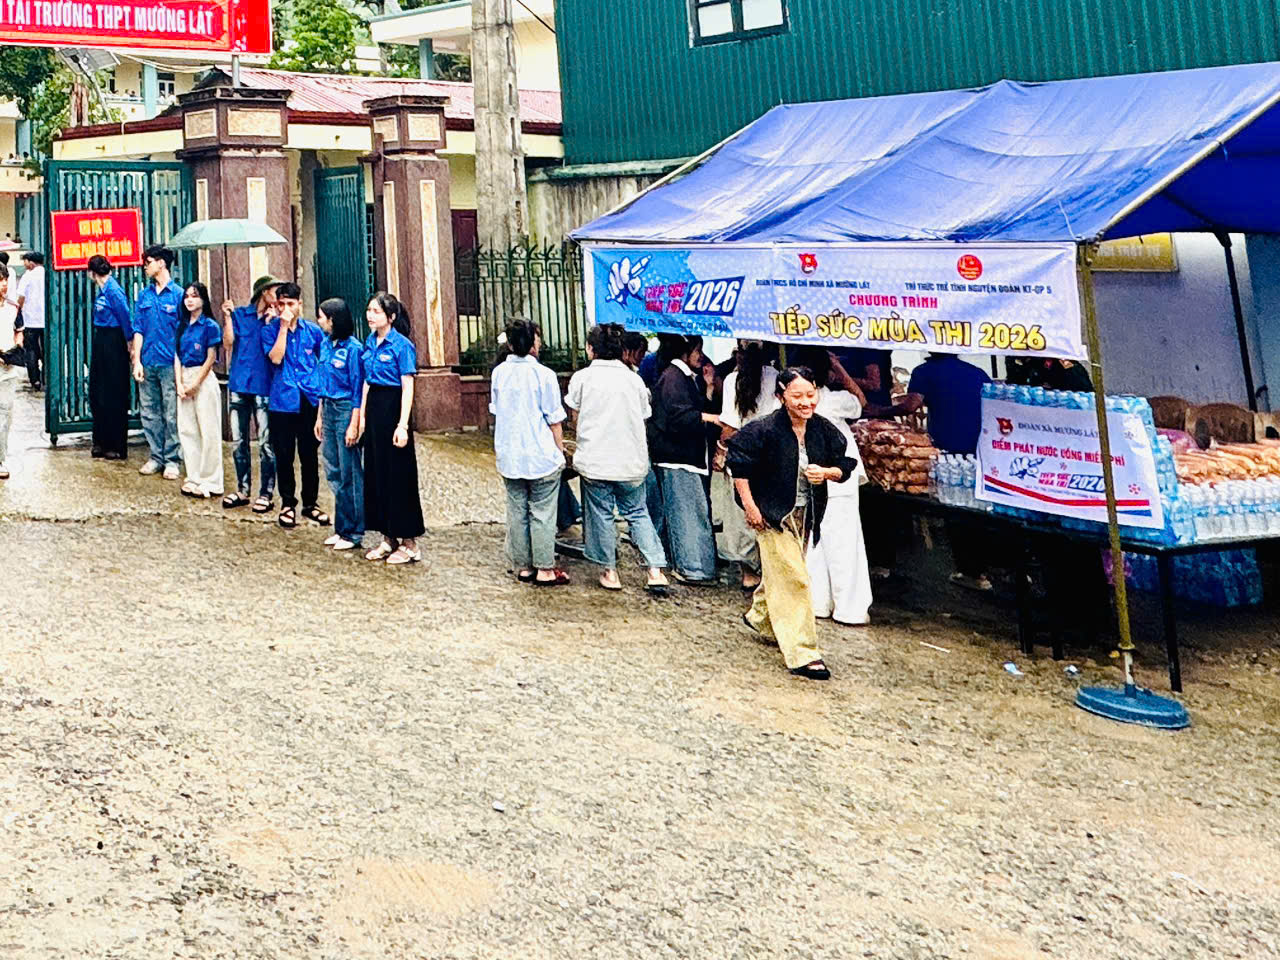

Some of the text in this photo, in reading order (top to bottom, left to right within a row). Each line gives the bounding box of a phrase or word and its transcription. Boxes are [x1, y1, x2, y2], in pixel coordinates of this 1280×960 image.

[96, 4, 130, 31] THPT
[134, 2, 186, 34] MƯỜNG
[189, 6, 214, 35] LÁT
[684, 280, 740, 313] 2026
[901, 294, 938, 309] TRÌNH
[768, 303, 812, 336] TIẾP
[815, 307, 863, 340] SỨC
[867, 310, 927, 344] MÙA
[928, 319, 971, 347] THI
[977, 322, 1047, 351] 2026
[1013, 442, 1034, 455] PHÁT
[1036, 445, 1058, 458] NƯỚC
[1060, 449, 1083, 462] UỐNG
